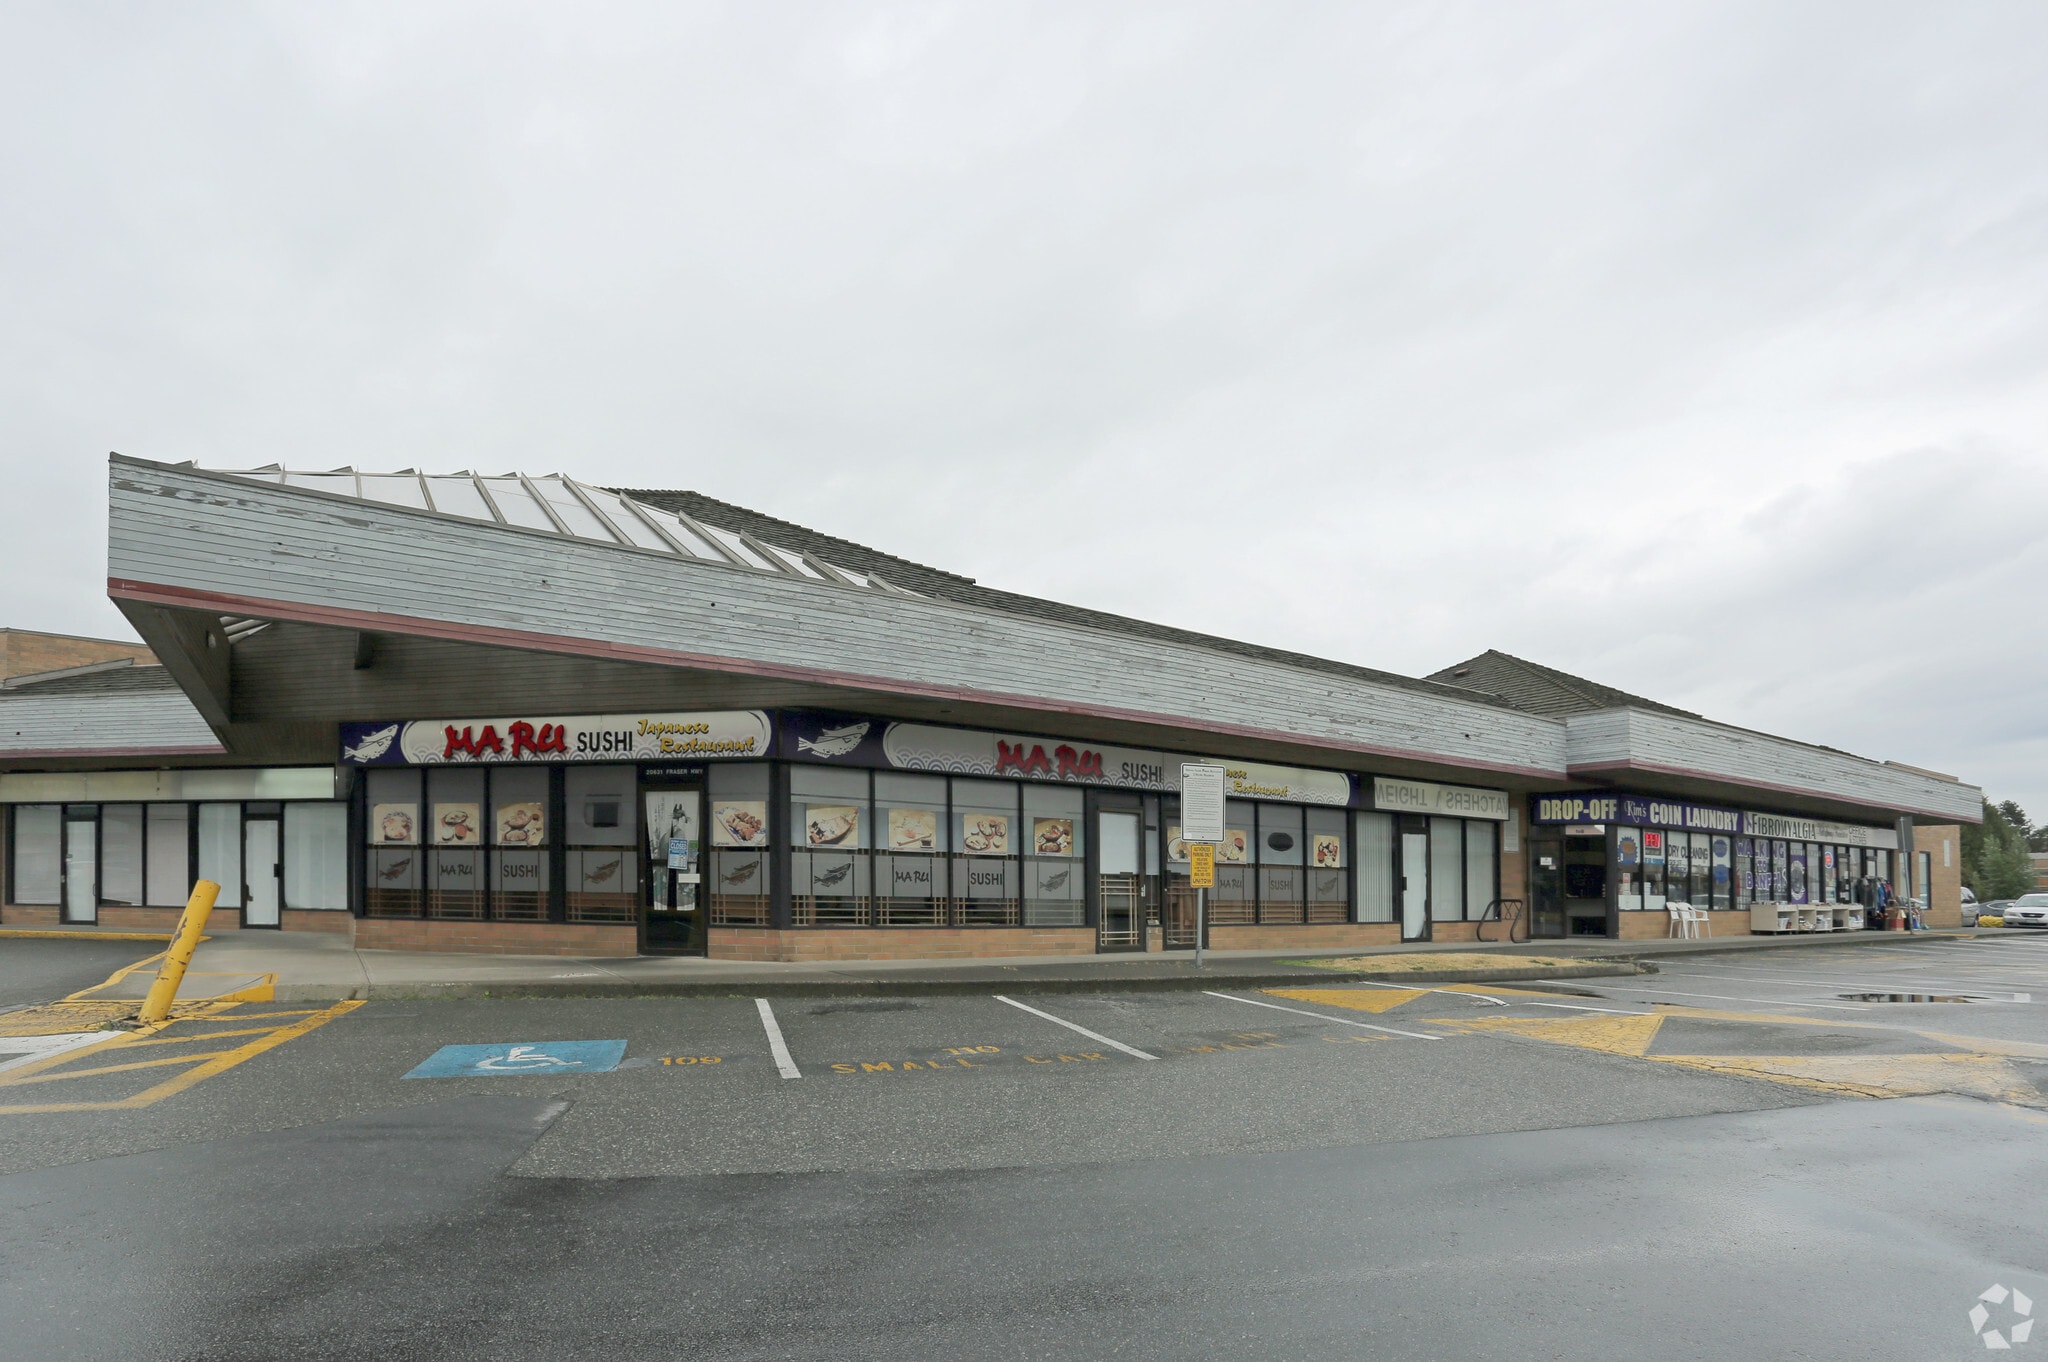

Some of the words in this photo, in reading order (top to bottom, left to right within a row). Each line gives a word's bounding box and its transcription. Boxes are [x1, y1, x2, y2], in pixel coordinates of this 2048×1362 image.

[637, 719, 708, 737] Japanese
[577, 732, 632, 752] SUSHI
[659, 738, 753, 753] Restaurant
[1122, 762, 1162, 783] SUSHI
[1233, 780, 1288, 796] Restaurant
[1540, 800, 1617, 820] DROP-OFF
[1624, 801, 1647, 823] Kim's
[1649, 803, 1682, 825] COIN
[1686, 808, 1738, 830] LAUNDRY
[1752, 814, 1816, 840] FIBROMYALGIA
[1668, 845, 1680, 857] DRY
[503, 865, 538, 878] SUSHI
[1757, 860, 1768, 872] TO
[970, 873, 1002, 885] SUSHI
[1270, 880, 1292, 890] SUSHI
[943, 1045, 1000, 1055] 110
[658, 1055, 722, 1066] 109
